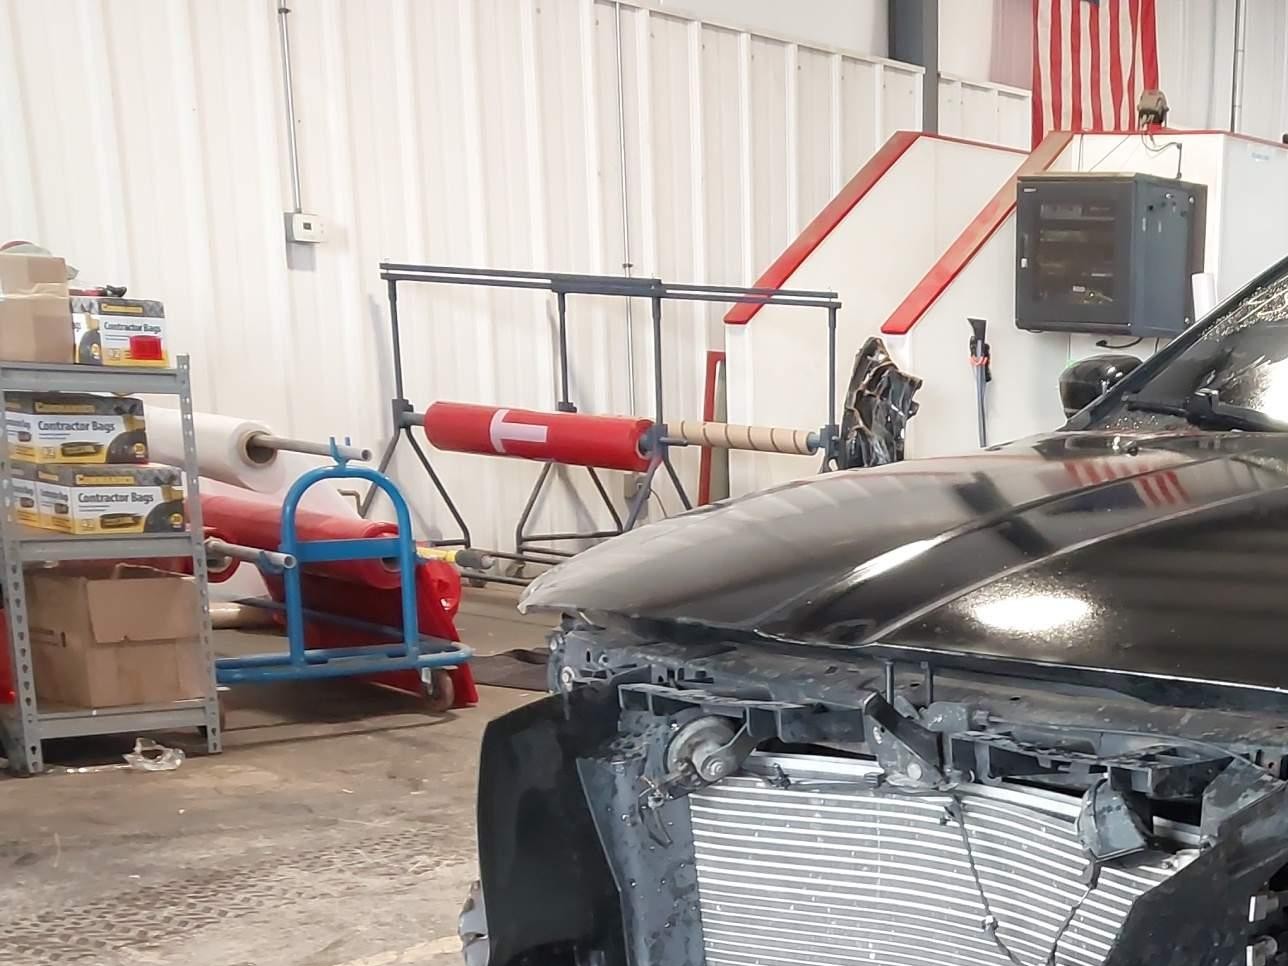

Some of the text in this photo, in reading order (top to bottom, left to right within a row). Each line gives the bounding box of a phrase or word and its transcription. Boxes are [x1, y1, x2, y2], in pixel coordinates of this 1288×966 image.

[103, 321, 142, 332] Contractor
[38, 420, 90, 432] Contractor
[92, 421, 115, 433] Bags
[78, 492, 129, 503] Contractor
[131, 492, 154, 504] Bags
